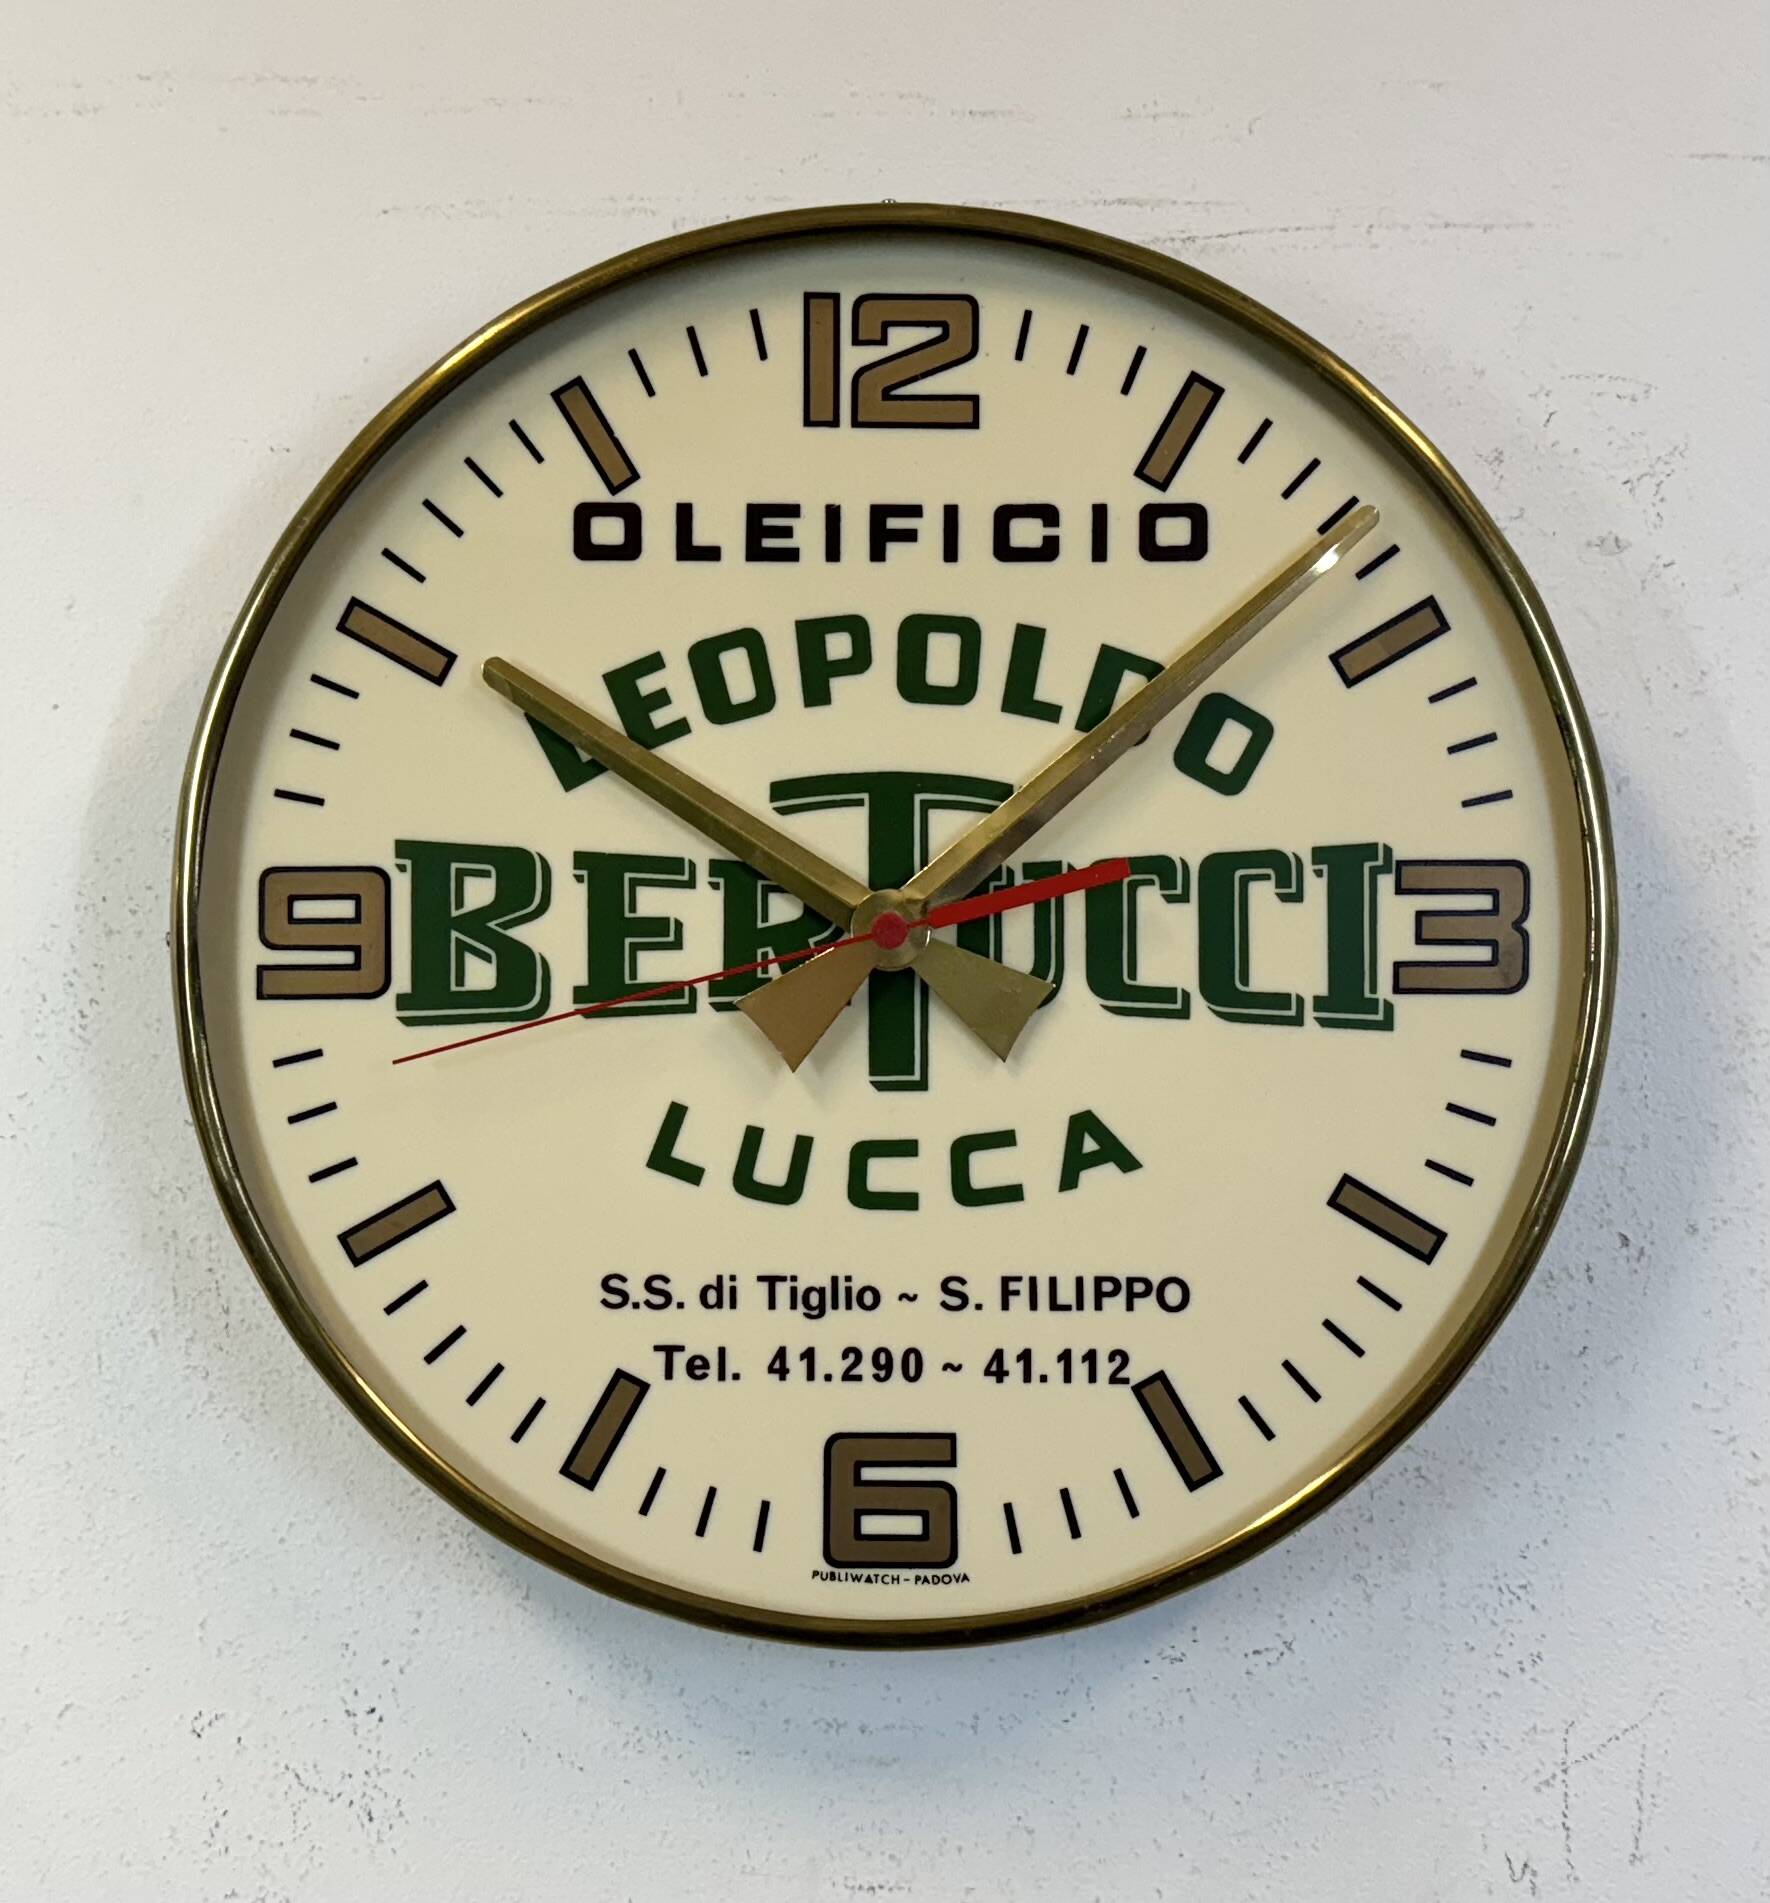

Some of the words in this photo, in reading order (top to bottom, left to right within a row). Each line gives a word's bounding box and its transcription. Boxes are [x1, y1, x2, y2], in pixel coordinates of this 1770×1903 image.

[803, 291, 980, 430] 12
[573, 502, 1208, 563] OLEIFICIO
[256, 866, 392, 1000] 9
[1392, 859, 1531, 995] 3
[645, 1100, 1143, 1211] LUCCA
[600, 1273, 685, 1310] S.S.
[699, 1275, 738, 1310] di
[757, 1275, 882, 1320] Tiglio
[939, 1275, 984, 1312] S.
[1000, 1275, 1191, 1313] FILIPPO
[653, 1344, 741, 1381] Tel.
[767, 1345, 924, 1384] 41.290
[983, 1347, 1131, 1385] 41.112
[822, 1432, 959, 1569] 6
[811, 1570, 900, 1585] PUBLIWATCH
[914, 1572, 970, 1586] PADOVA
